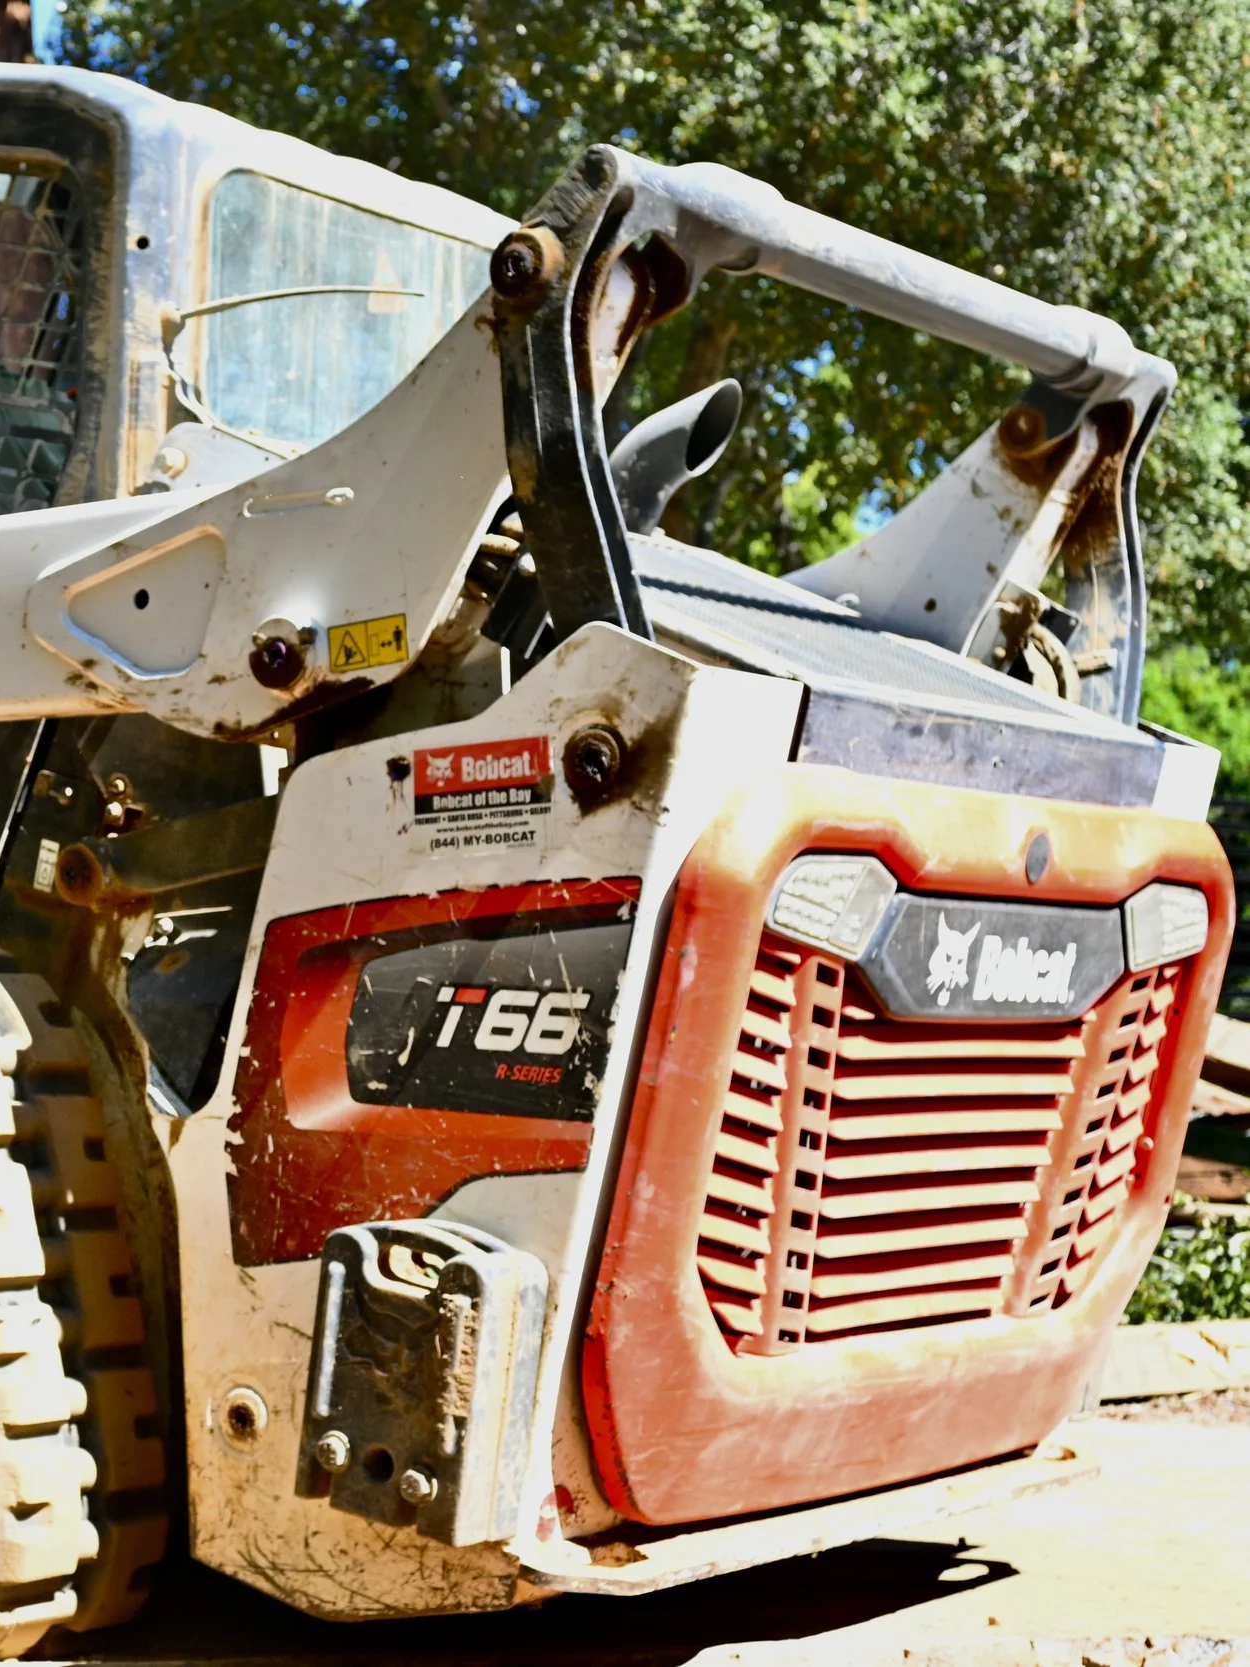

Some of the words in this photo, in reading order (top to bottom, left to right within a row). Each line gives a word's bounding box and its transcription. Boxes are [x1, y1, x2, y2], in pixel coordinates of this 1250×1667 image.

[461, 751, 533, 783] Bobcat
[433, 793, 473, 810] Bobcat
[474, 791, 486, 807] of
[488, 789, 508, 805] the
[509, 788, 531, 804] Bay
[430, 836, 460, 851] (844)
[464, 830, 536, 846] MY-BOBCAT
[973, 935, 1078, 1004] Bobcat
[495, 1063, 562, 1084] R-SERIES
